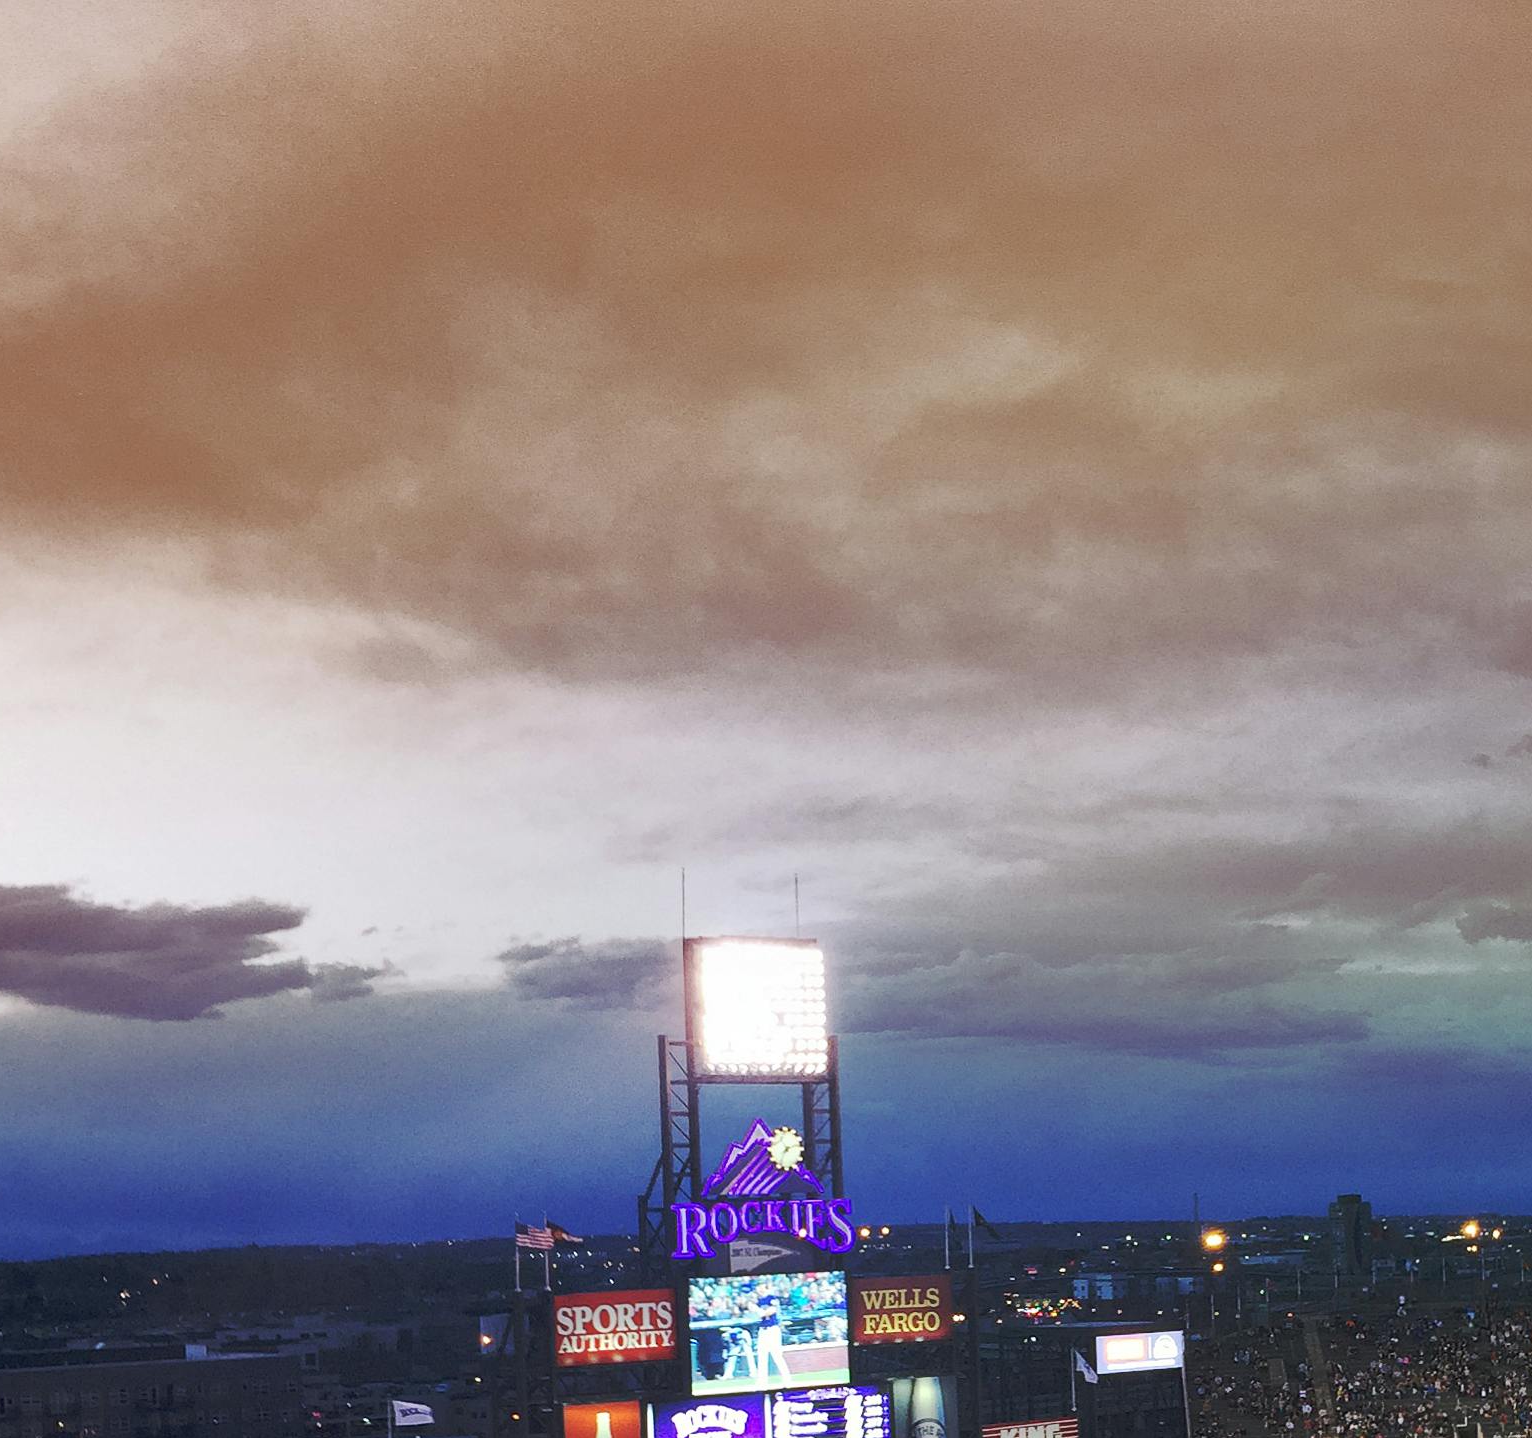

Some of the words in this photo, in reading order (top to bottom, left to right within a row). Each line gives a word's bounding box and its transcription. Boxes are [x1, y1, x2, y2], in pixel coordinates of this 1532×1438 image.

[671, 1198, 856, 1260] ROCKIES
[861, 1288, 940, 1310] WELLS
[556, 1302, 673, 1335] SPORTS
[863, 1312, 941, 1334] FARGO
